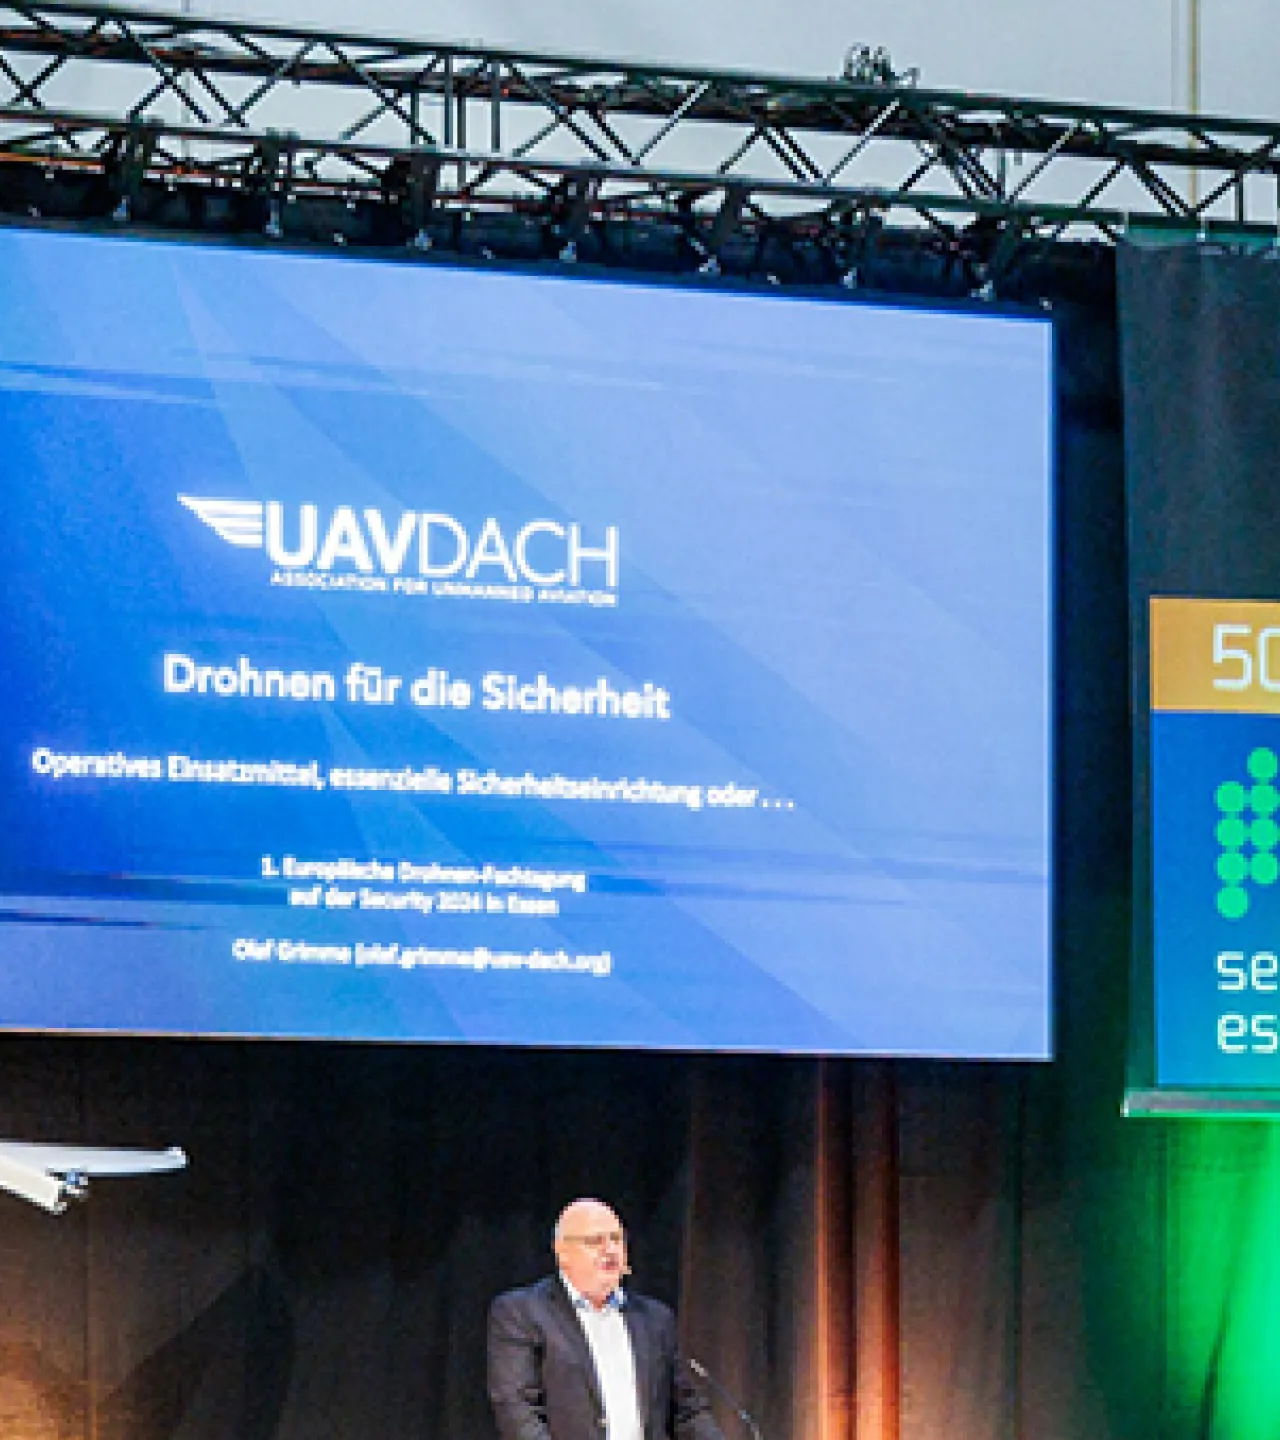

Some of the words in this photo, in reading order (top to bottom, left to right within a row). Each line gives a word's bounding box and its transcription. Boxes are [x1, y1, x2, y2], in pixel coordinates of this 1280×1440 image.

[262, 499, 619, 587] UAVDACH
[270, 571, 387, 590] ASSOCIATION
[393, 577, 429, 595] FOR
[432, 579, 535, 601] UNMANNED
[537, 587, 617, 605] AVIATION
[163, 654, 335, 700] Drohnen
[345, 660, 400, 704] für
[411, 668, 472, 708] die
[482, 672, 672, 718] Sicherheit
[32, 746, 161, 778] Operatives
[167, 754, 324, 789] Einsatzmittel,
[329, 765, 452, 794] essenzielle
[456, 767, 702, 809] Sicherheitseinrichtung
[706, 782, 758, 806] oder
[283, 855, 395, 880] Europäische
[290, 883, 323, 904] auf
[326, 885, 357, 906] der
[360, 886, 434, 913] Security
[507, 890, 560, 914] Essen
